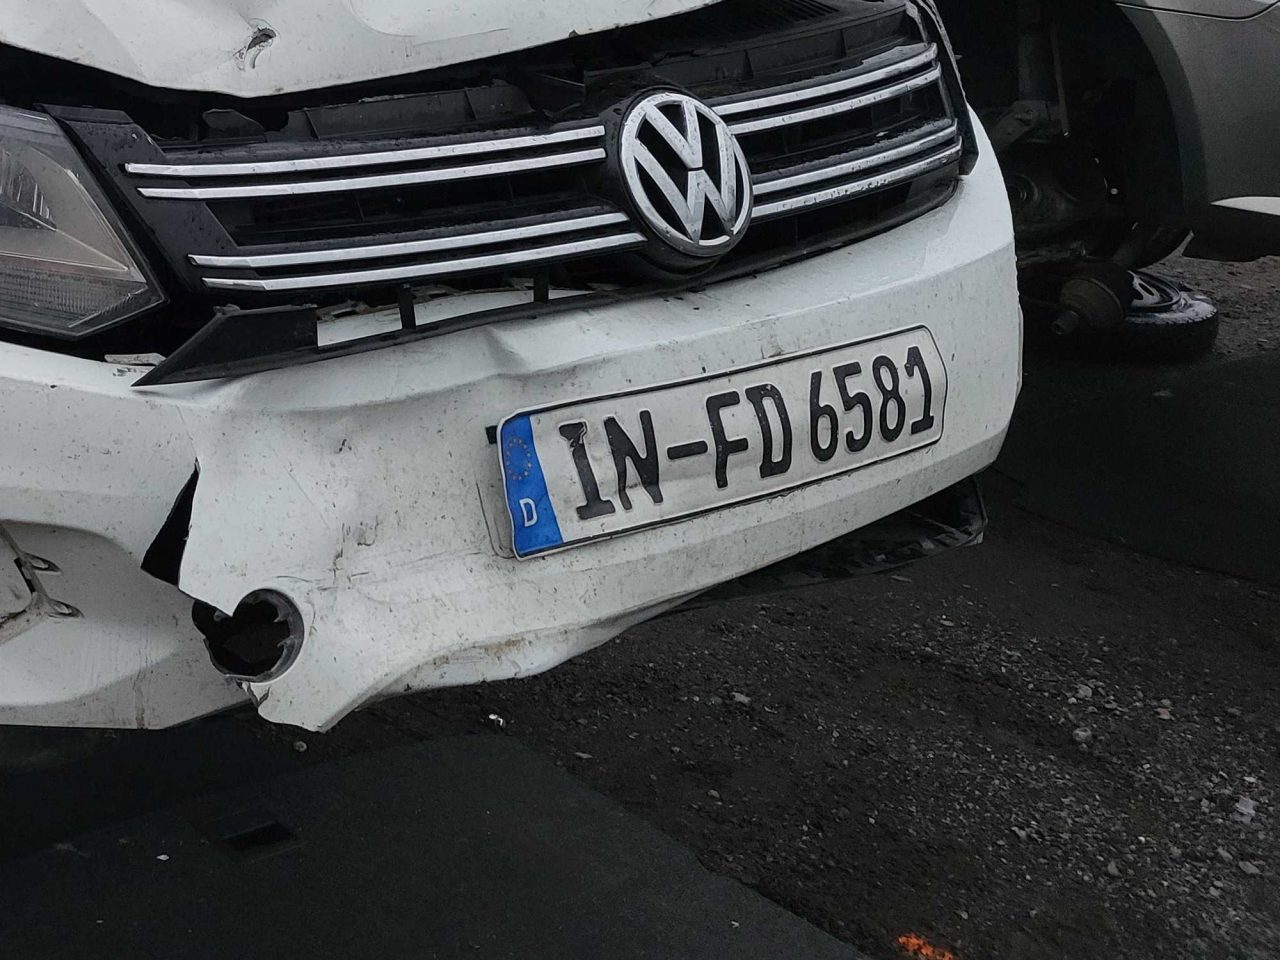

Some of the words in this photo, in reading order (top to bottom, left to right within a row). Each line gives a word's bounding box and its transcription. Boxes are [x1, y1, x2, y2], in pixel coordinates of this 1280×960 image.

[622, 93, 751, 246] VW
[809, 345, 936, 464] 6581
[519, 497, 538, 528] D
